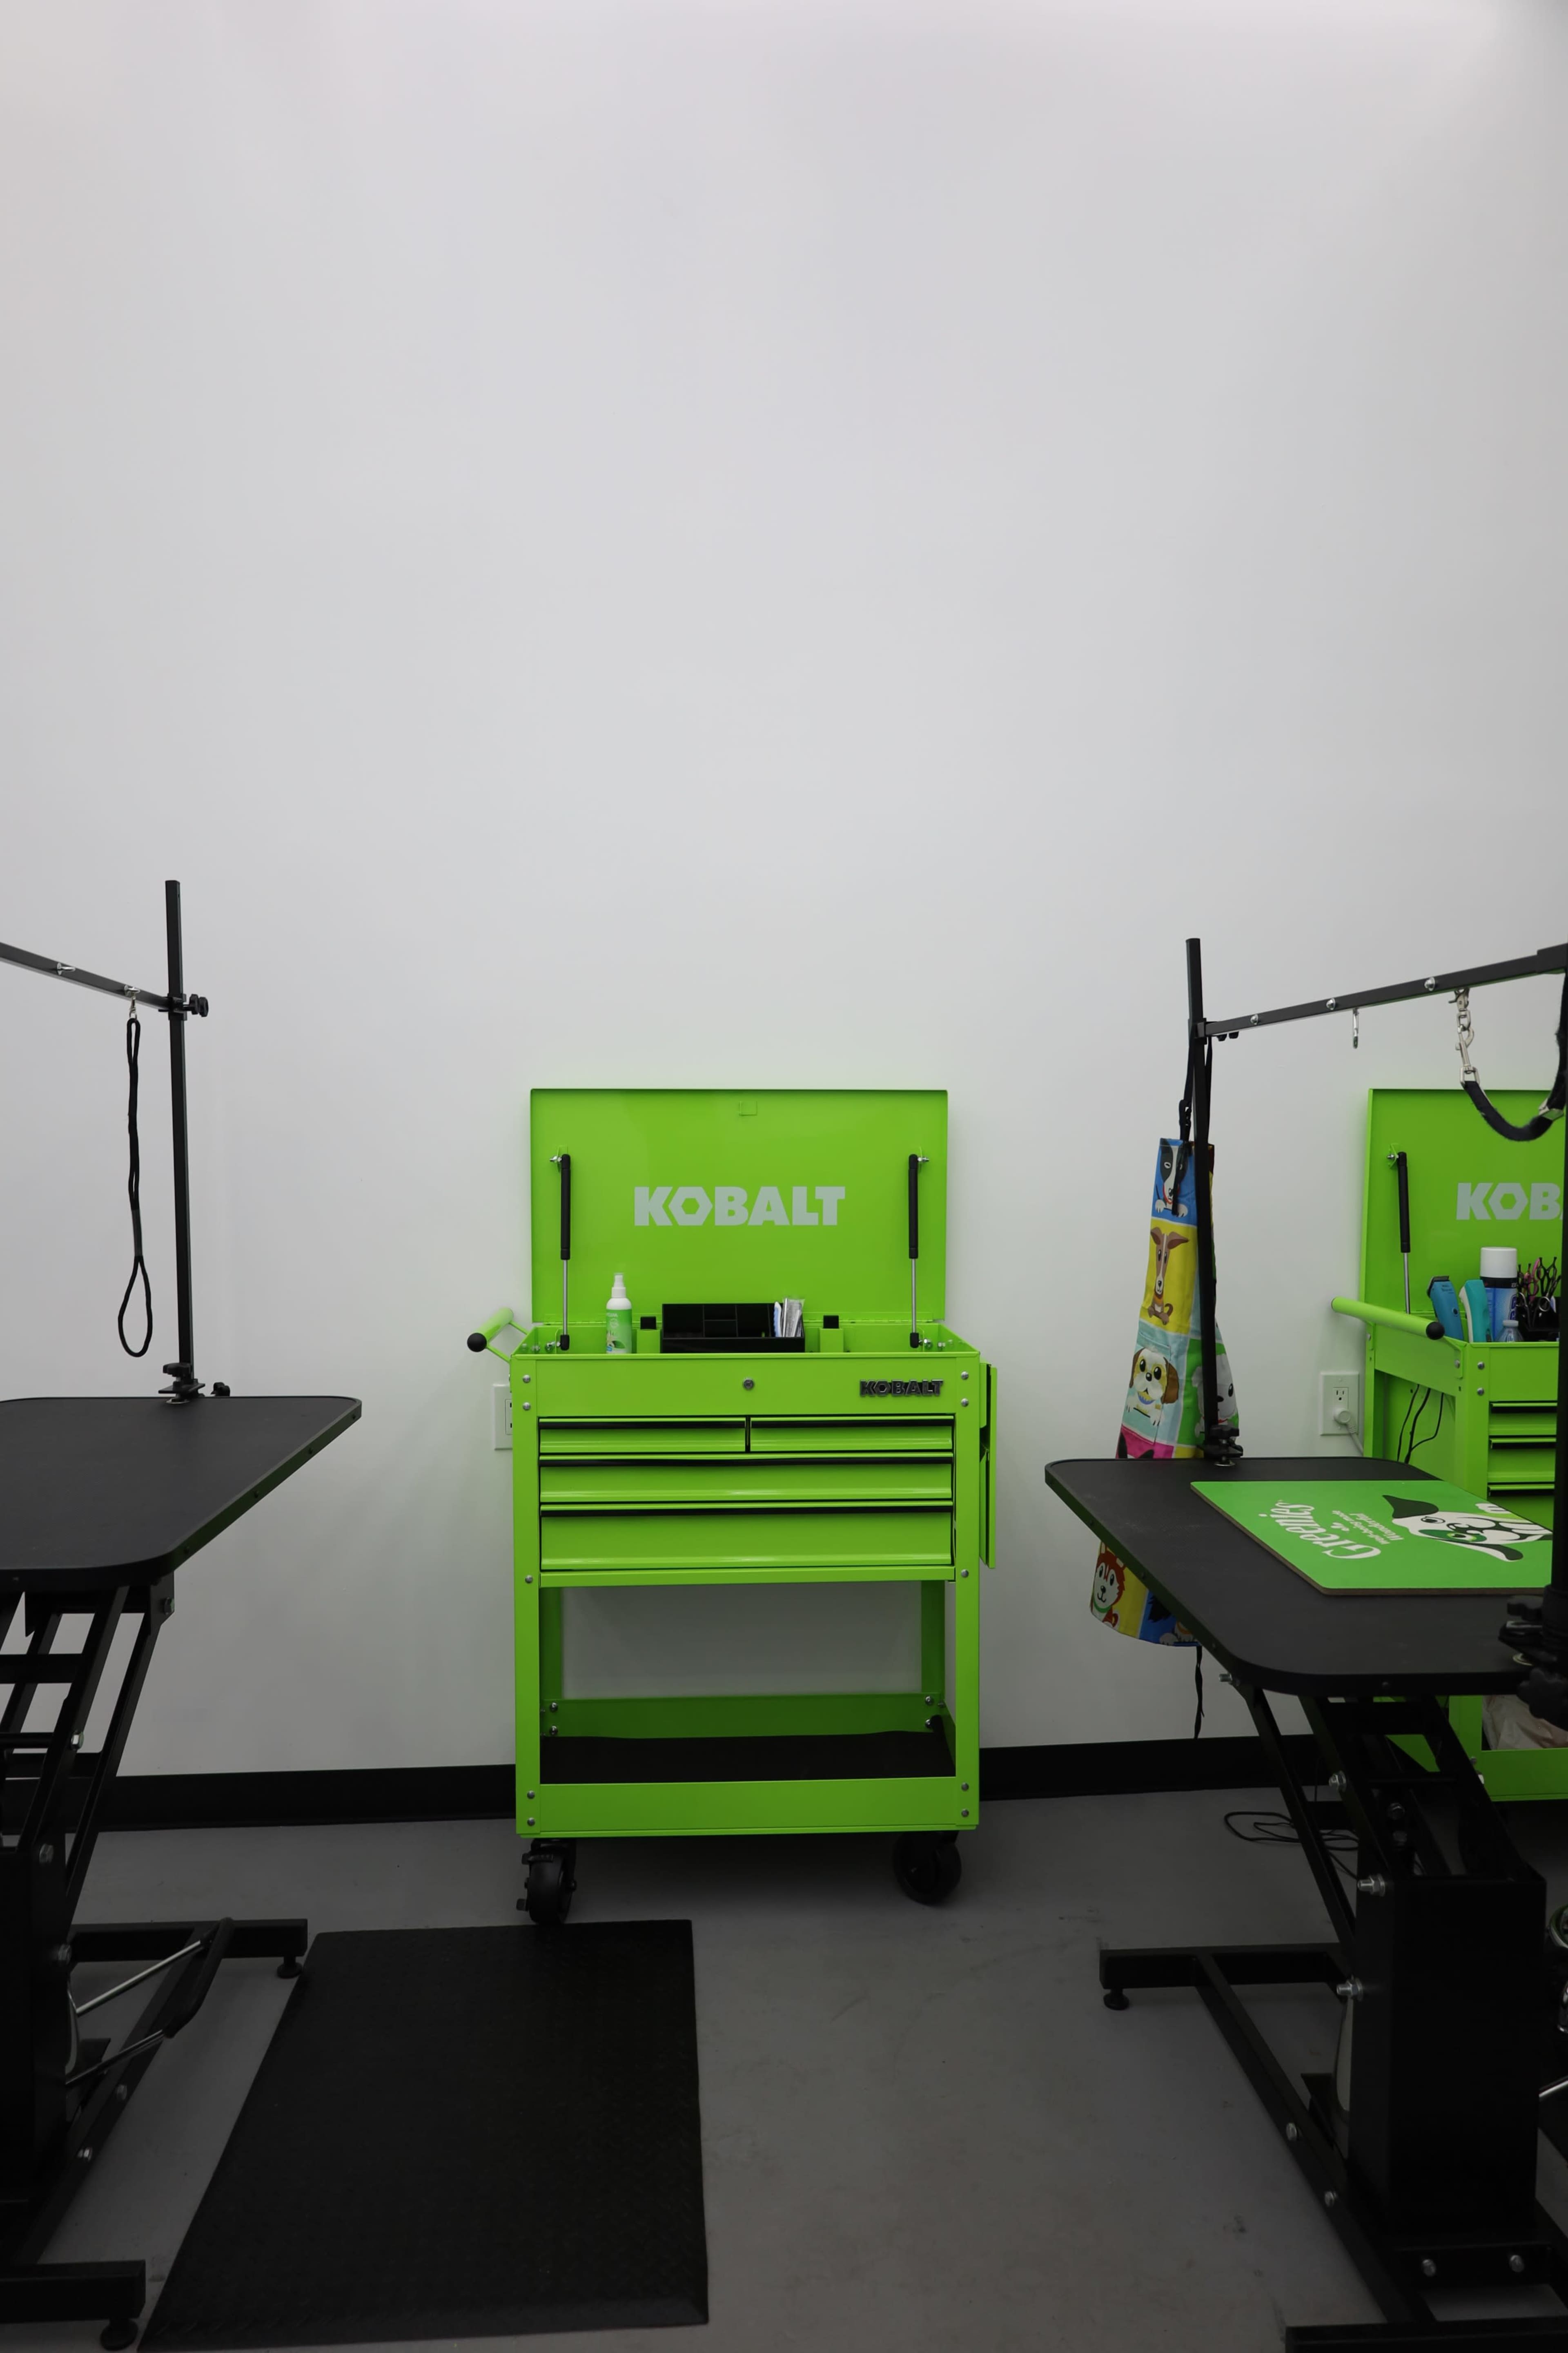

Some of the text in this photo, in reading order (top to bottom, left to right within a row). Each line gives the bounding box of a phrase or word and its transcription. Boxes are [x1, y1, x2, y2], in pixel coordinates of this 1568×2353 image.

[634, 1186, 845, 1226] KOBALT
[1456, 1182, 1563, 1220] KOB
[860, 1379, 943, 1396] KOBALT
[1258, 1501, 1381, 1559] Greenies
[1350, 1513, 1403, 1540] Wonderful
